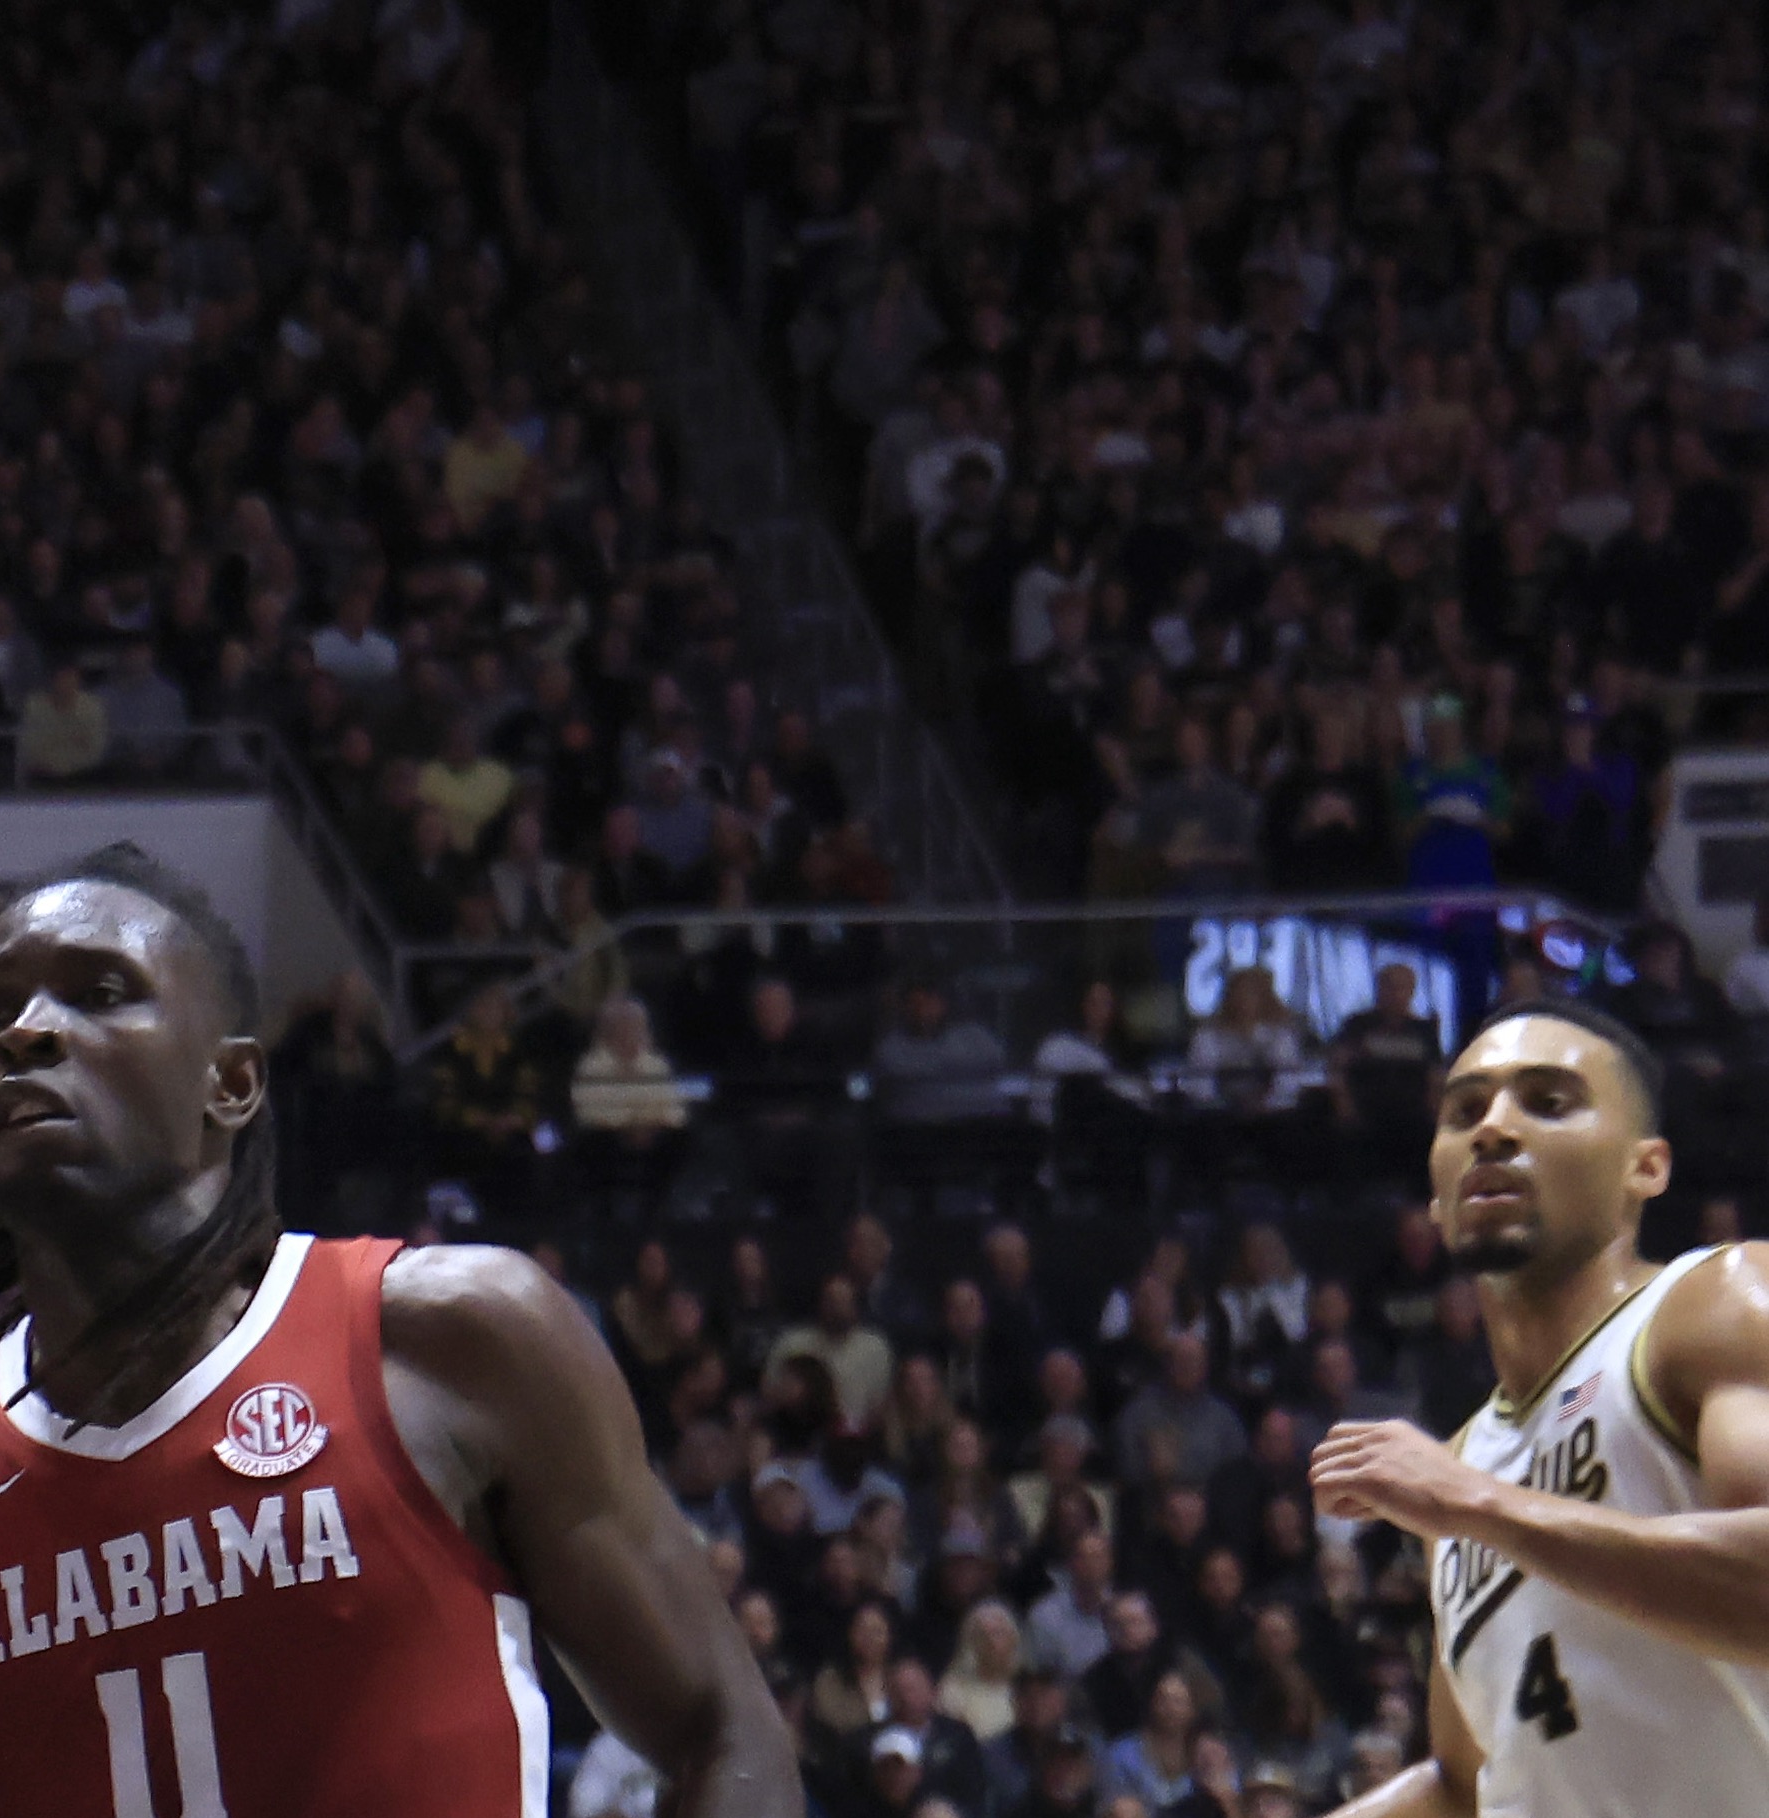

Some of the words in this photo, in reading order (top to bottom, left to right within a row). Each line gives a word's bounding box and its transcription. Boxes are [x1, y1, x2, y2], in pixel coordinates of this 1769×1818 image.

[235, 1388, 308, 1454] SEC
[226, 1442, 316, 1478] GRADUATE
[1516, 1631, 1580, 1743] 4
